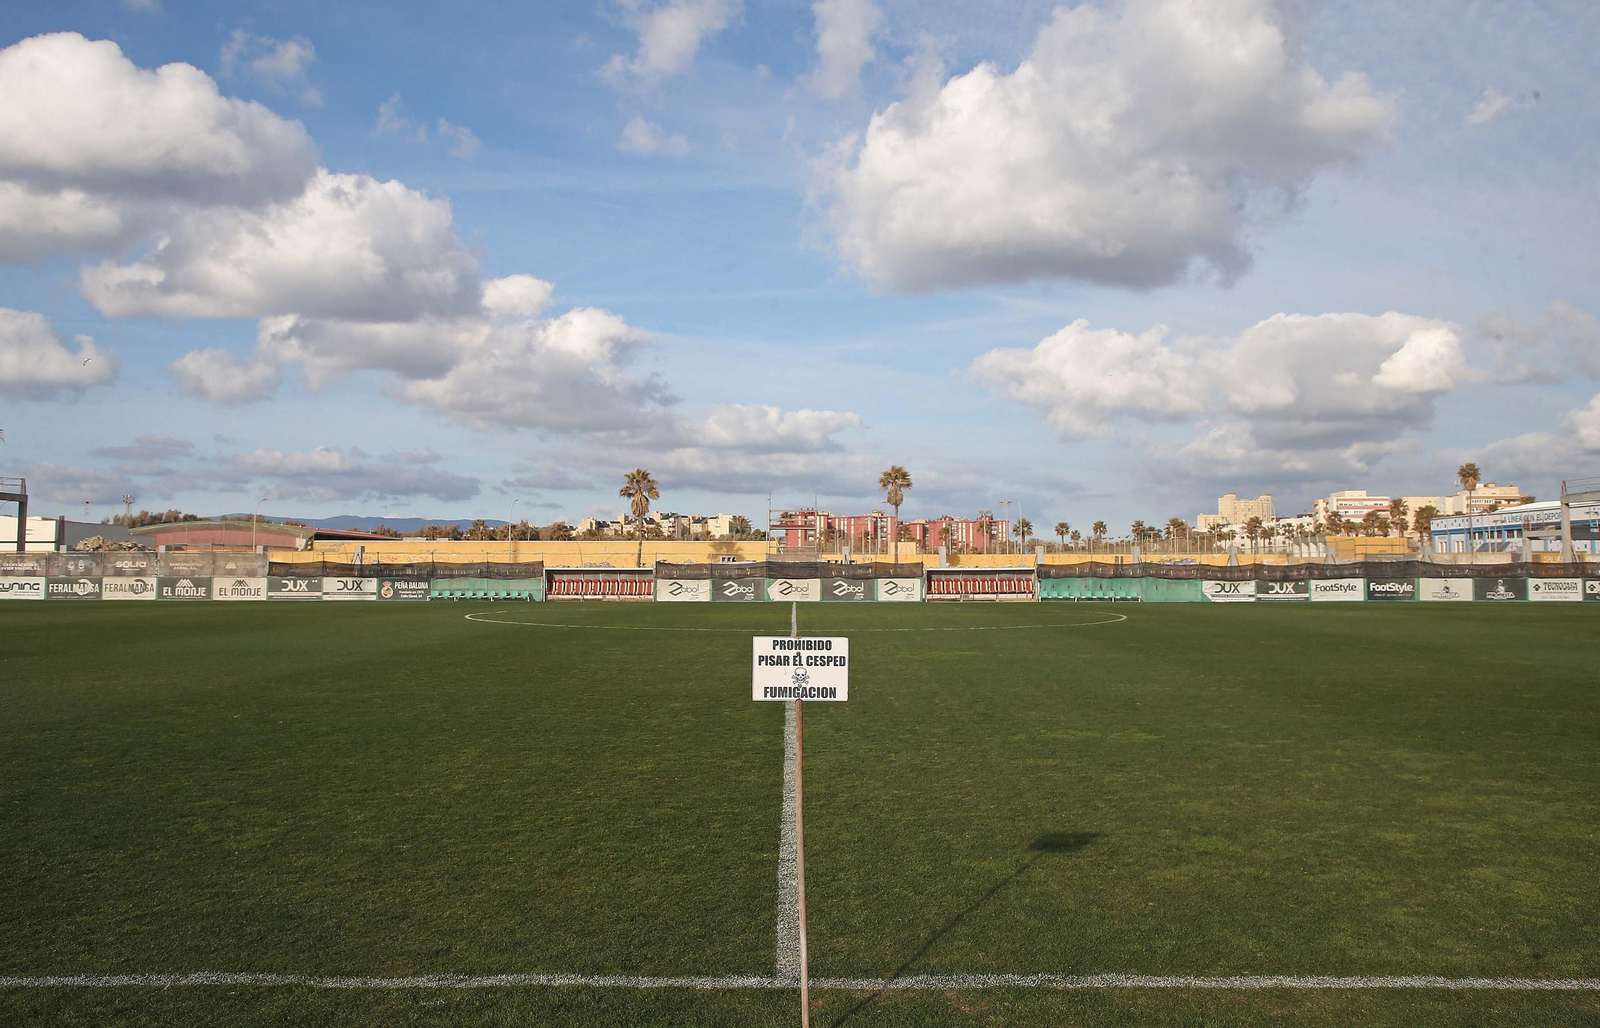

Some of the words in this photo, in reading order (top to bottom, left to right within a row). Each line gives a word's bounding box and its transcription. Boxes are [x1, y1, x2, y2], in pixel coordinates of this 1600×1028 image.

[1536, 513, 1543, 521] EL
[49, 583, 100, 593] FERALMANSA
[104, 583, 155, 593] FERALMANSA
[281, 580, 309, 592] DUX
[336, 580, 363, 591] DUX
[1214, 582, 1240, 593] DUX
[1268, 582, 1295, 594] DUX
[1315, 583, 1357, 593] FootStyle
[1369, 582, 1414, 593] FootStyle
[162, 587, 173, 596] EL
[219, 587, 228, 596] EL
[772, 639, 832, 651] PROHIBIDO
[758, 655, 790, 666] PISAR
[792, 655, 804, 666] EL
[805, 655, 846, 667] CESPED
[763, 686, 837, 699] FUMIGACION
